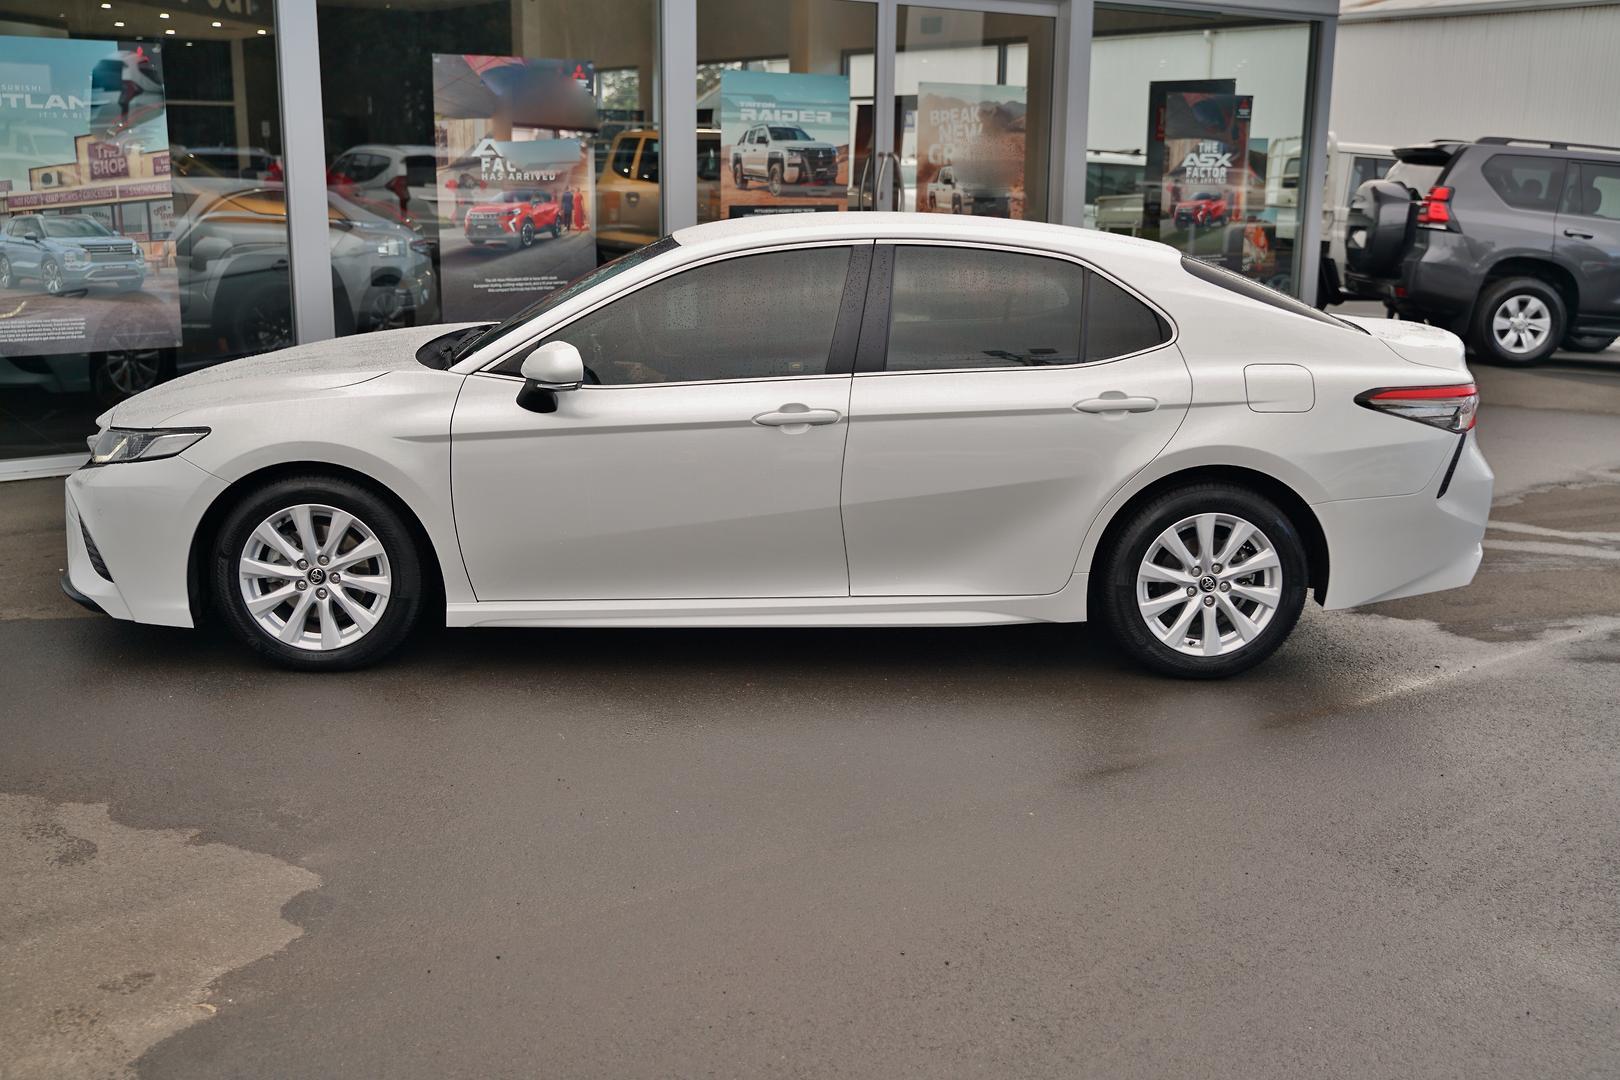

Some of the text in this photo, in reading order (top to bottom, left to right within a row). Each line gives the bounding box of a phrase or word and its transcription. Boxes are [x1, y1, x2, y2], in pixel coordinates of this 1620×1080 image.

[740, 108, 833, 123] RAIDER
[929, 106, 981, 128] BREAK
[1198, 141, 1219, 153] THE
[92, 158, 126, 175] SHOP
[1181, 152, 1233, 168] ASX
[481, 172, 556, 181] HAS ARRIVED
[1185, 167, 1227, 178] FACTOR
